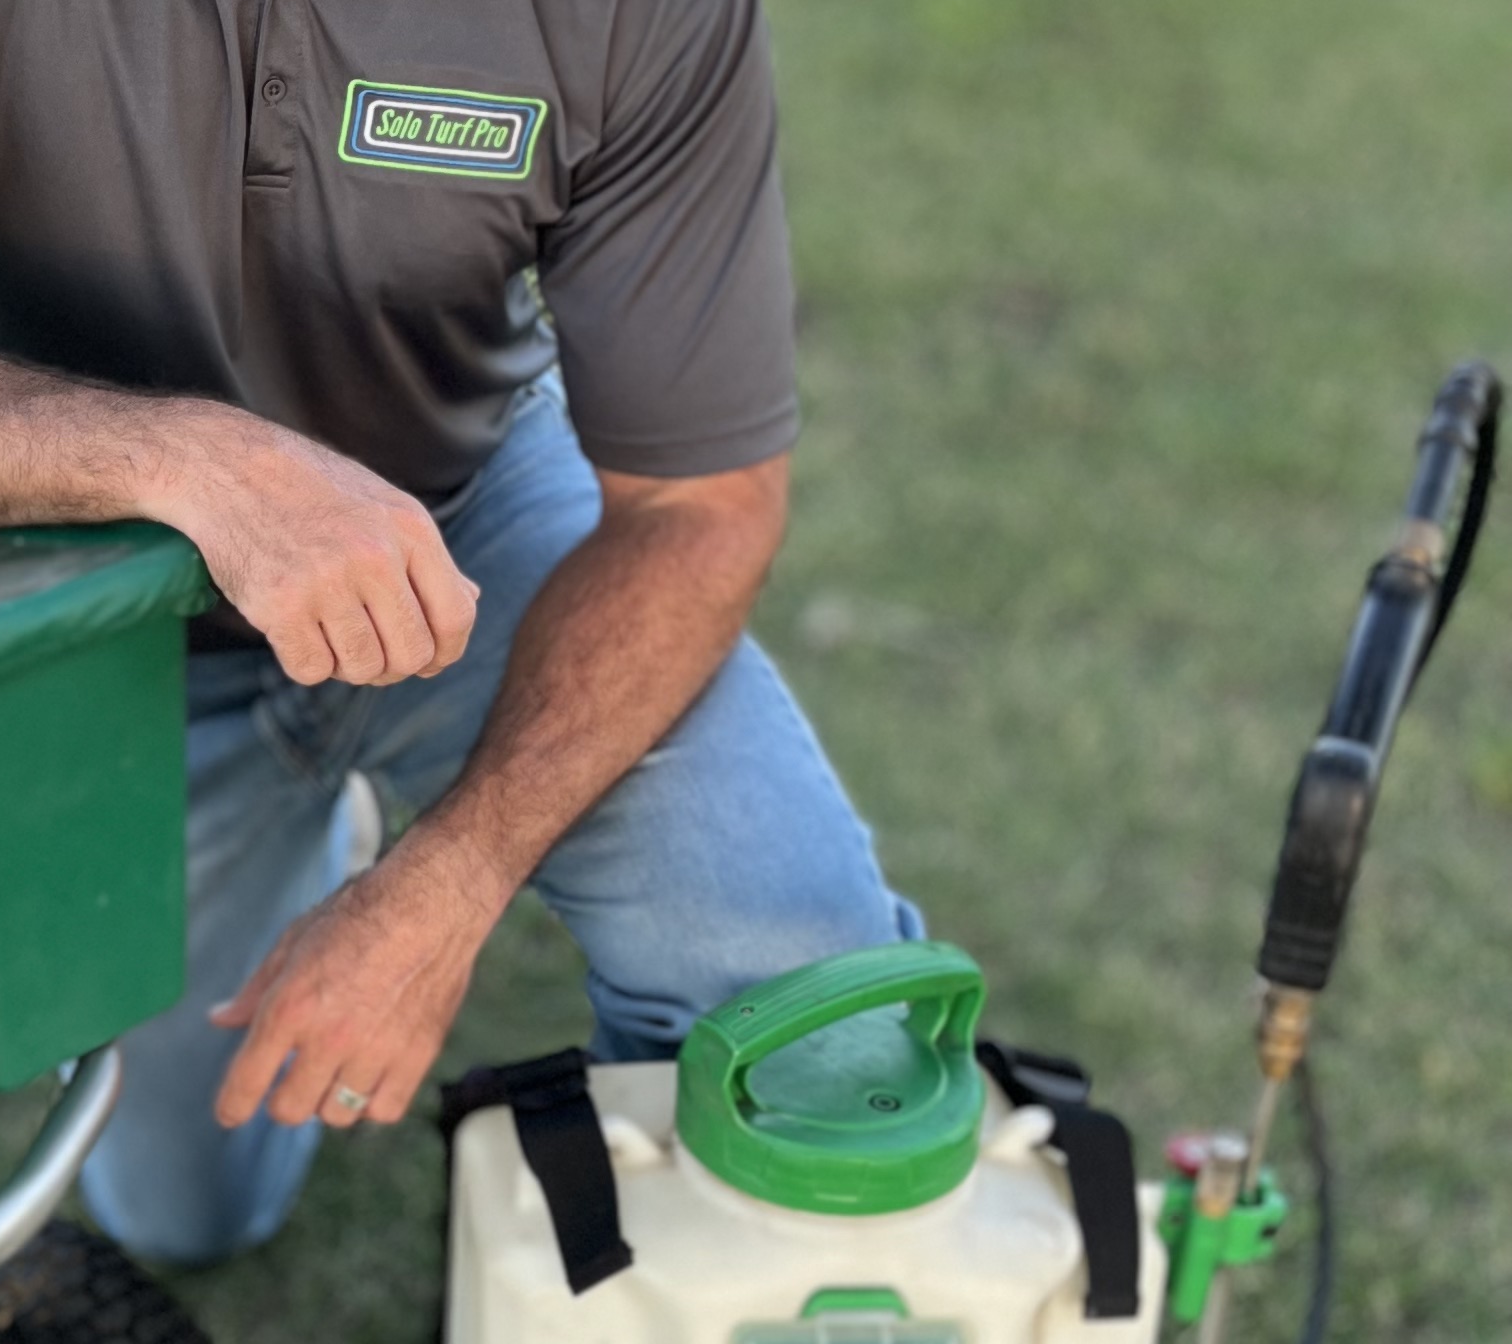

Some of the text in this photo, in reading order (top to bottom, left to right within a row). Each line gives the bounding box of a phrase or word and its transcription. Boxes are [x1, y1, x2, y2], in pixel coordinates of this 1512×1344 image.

[375, 108, 509, 149] Solo Turf Pro
